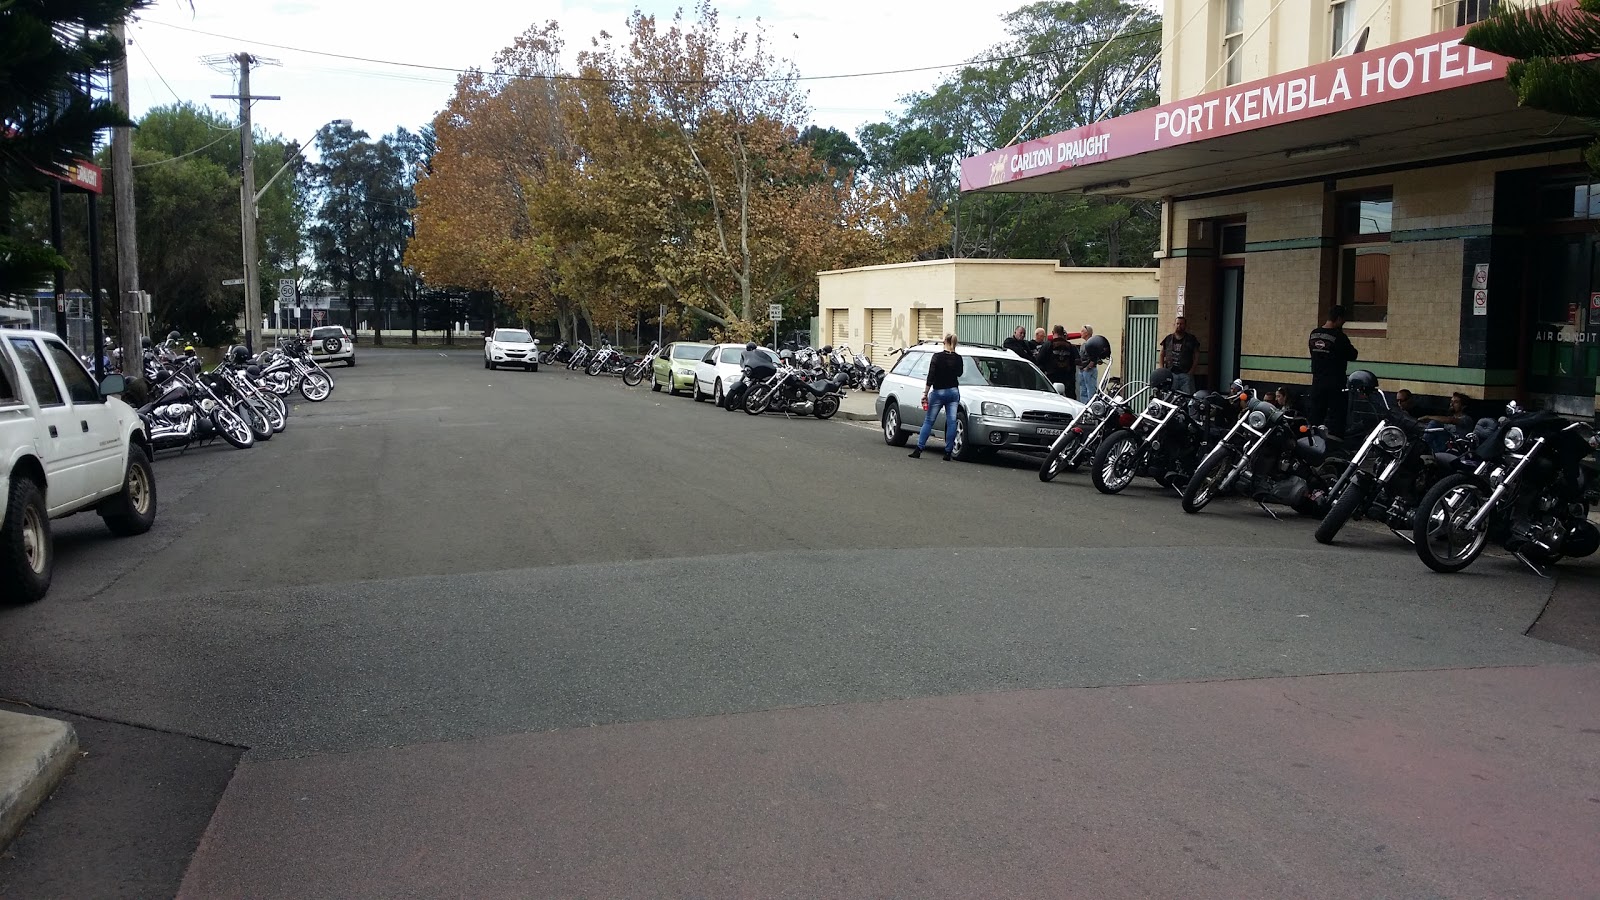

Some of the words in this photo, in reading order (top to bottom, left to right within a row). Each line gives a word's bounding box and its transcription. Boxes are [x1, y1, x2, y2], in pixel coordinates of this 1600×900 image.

[1154, 98, 1220, 140] PORT
[1224, 67, 1352, 126] KEMBLA
[1360, 37, 1493, 97] HOTEL
[1010, 146, 1053, 173] CARLTON
[1057, 133, 1111, 163] DRAUGHT
[1535, 331, 1554, 341] AIR
